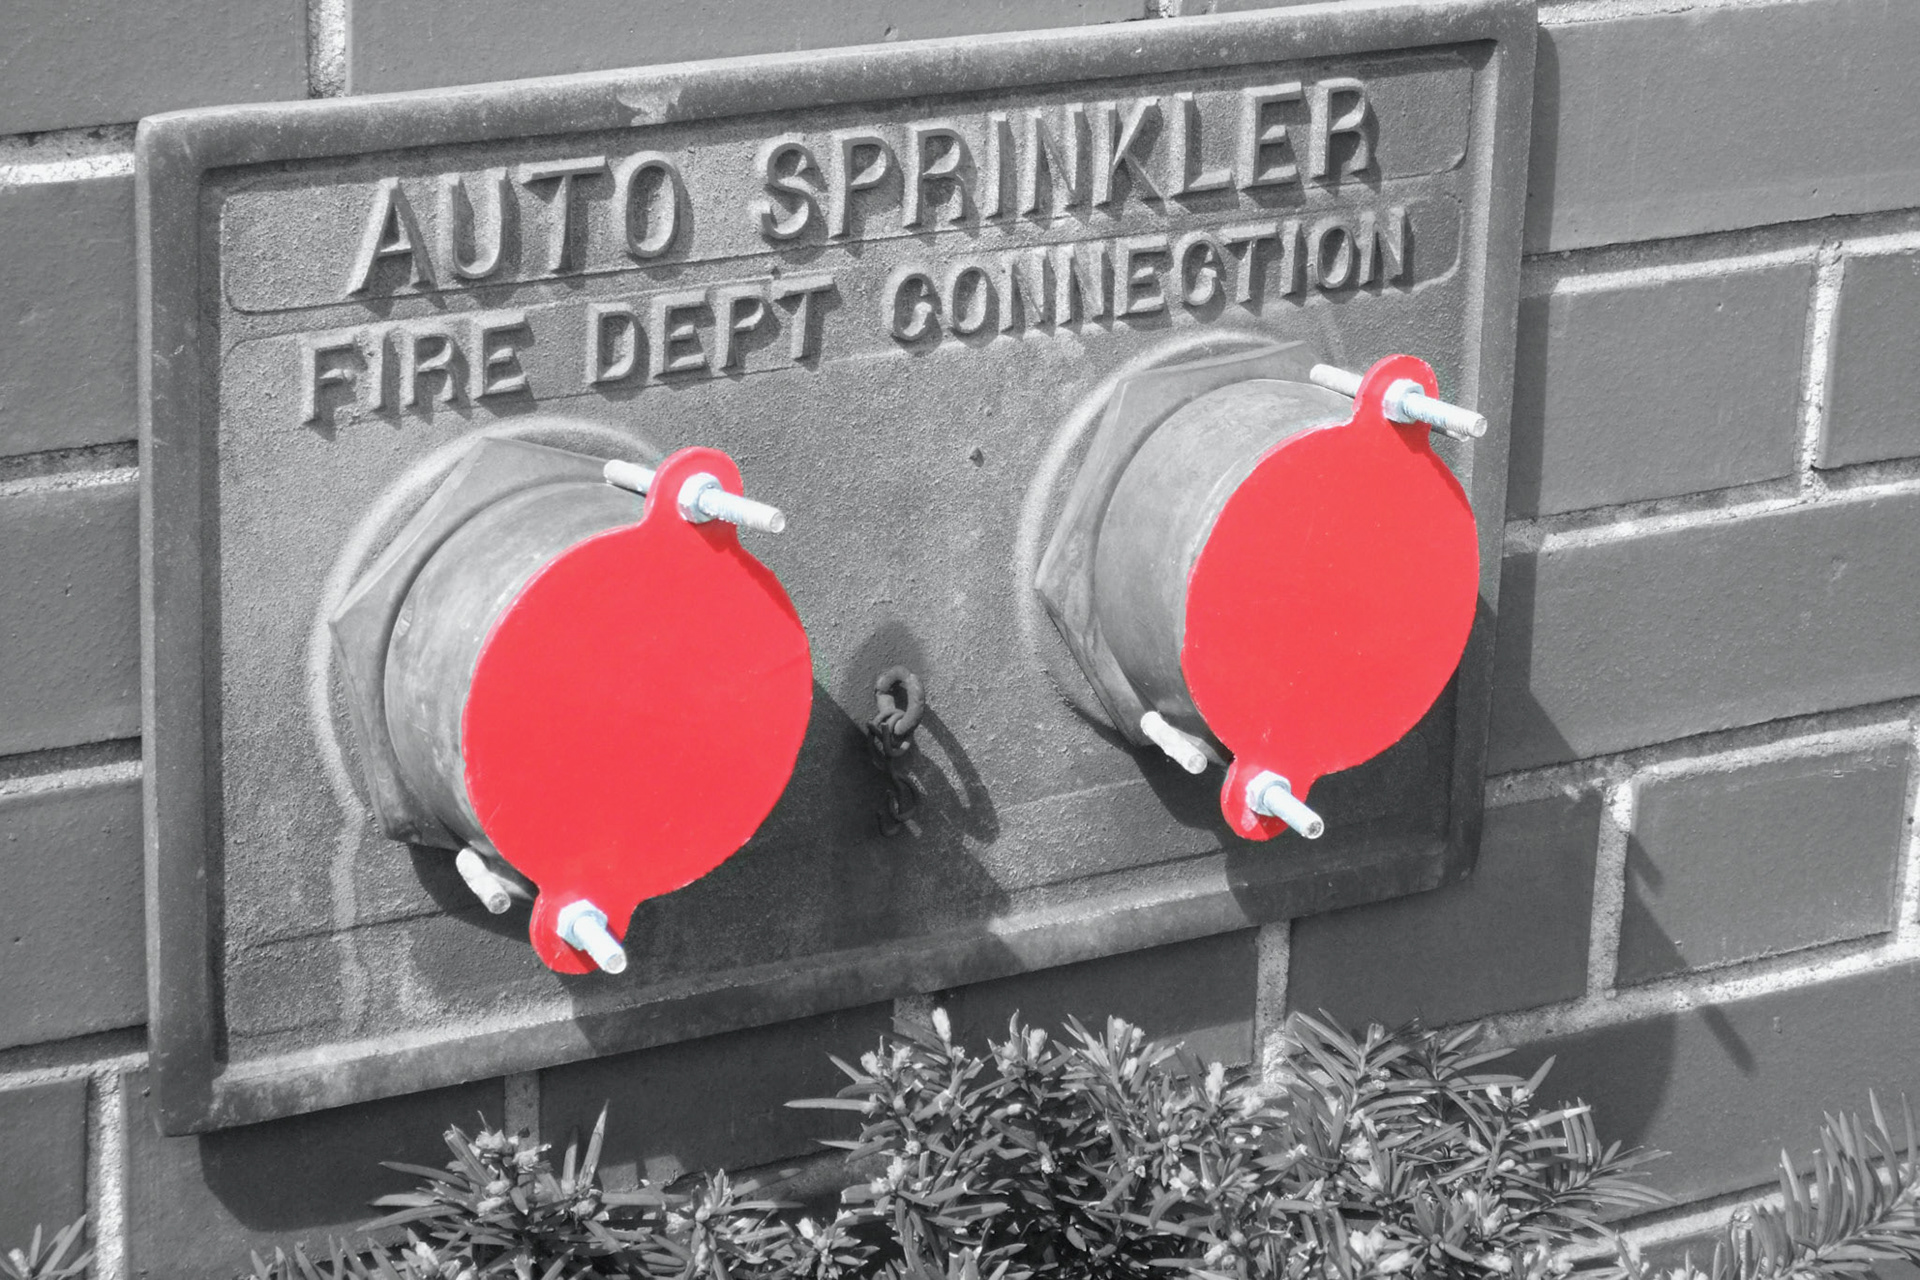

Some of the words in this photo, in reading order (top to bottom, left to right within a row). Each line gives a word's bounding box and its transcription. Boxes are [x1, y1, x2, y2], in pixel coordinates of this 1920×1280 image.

[347, 150, 682, 297] AUTO
[756, 77, 1372, 240] SPRINKLER
[302, 311, 529, 425] FIRE
[587, 273, 837, 385] DEPT
[887, 205, 1409, 342] CONNECTION
